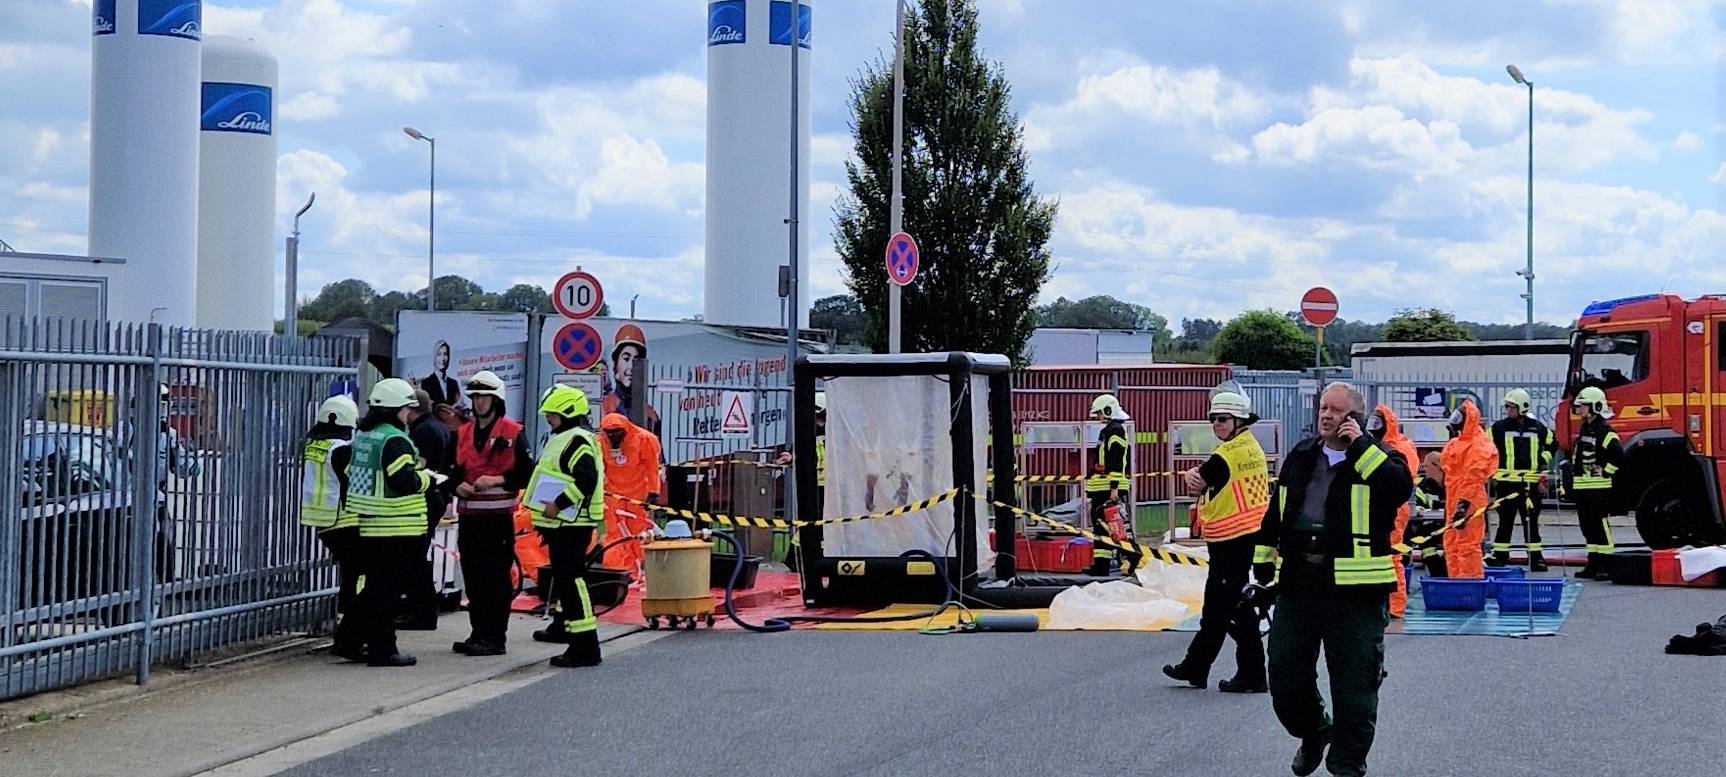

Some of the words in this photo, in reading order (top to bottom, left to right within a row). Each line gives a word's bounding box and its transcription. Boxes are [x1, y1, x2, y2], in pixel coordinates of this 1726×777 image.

[169, 21, 200, 38] Lin
[709, 25, 743, 41] Linde
[217, 111, 270, 132] Linde
[567, 285, 590, 306] 10
[714, 361, 734, 381] sind
[737, 359, 752, 377] die
[756, 355, 786, 377] ugend
[696, 391, 722, 409] heut
